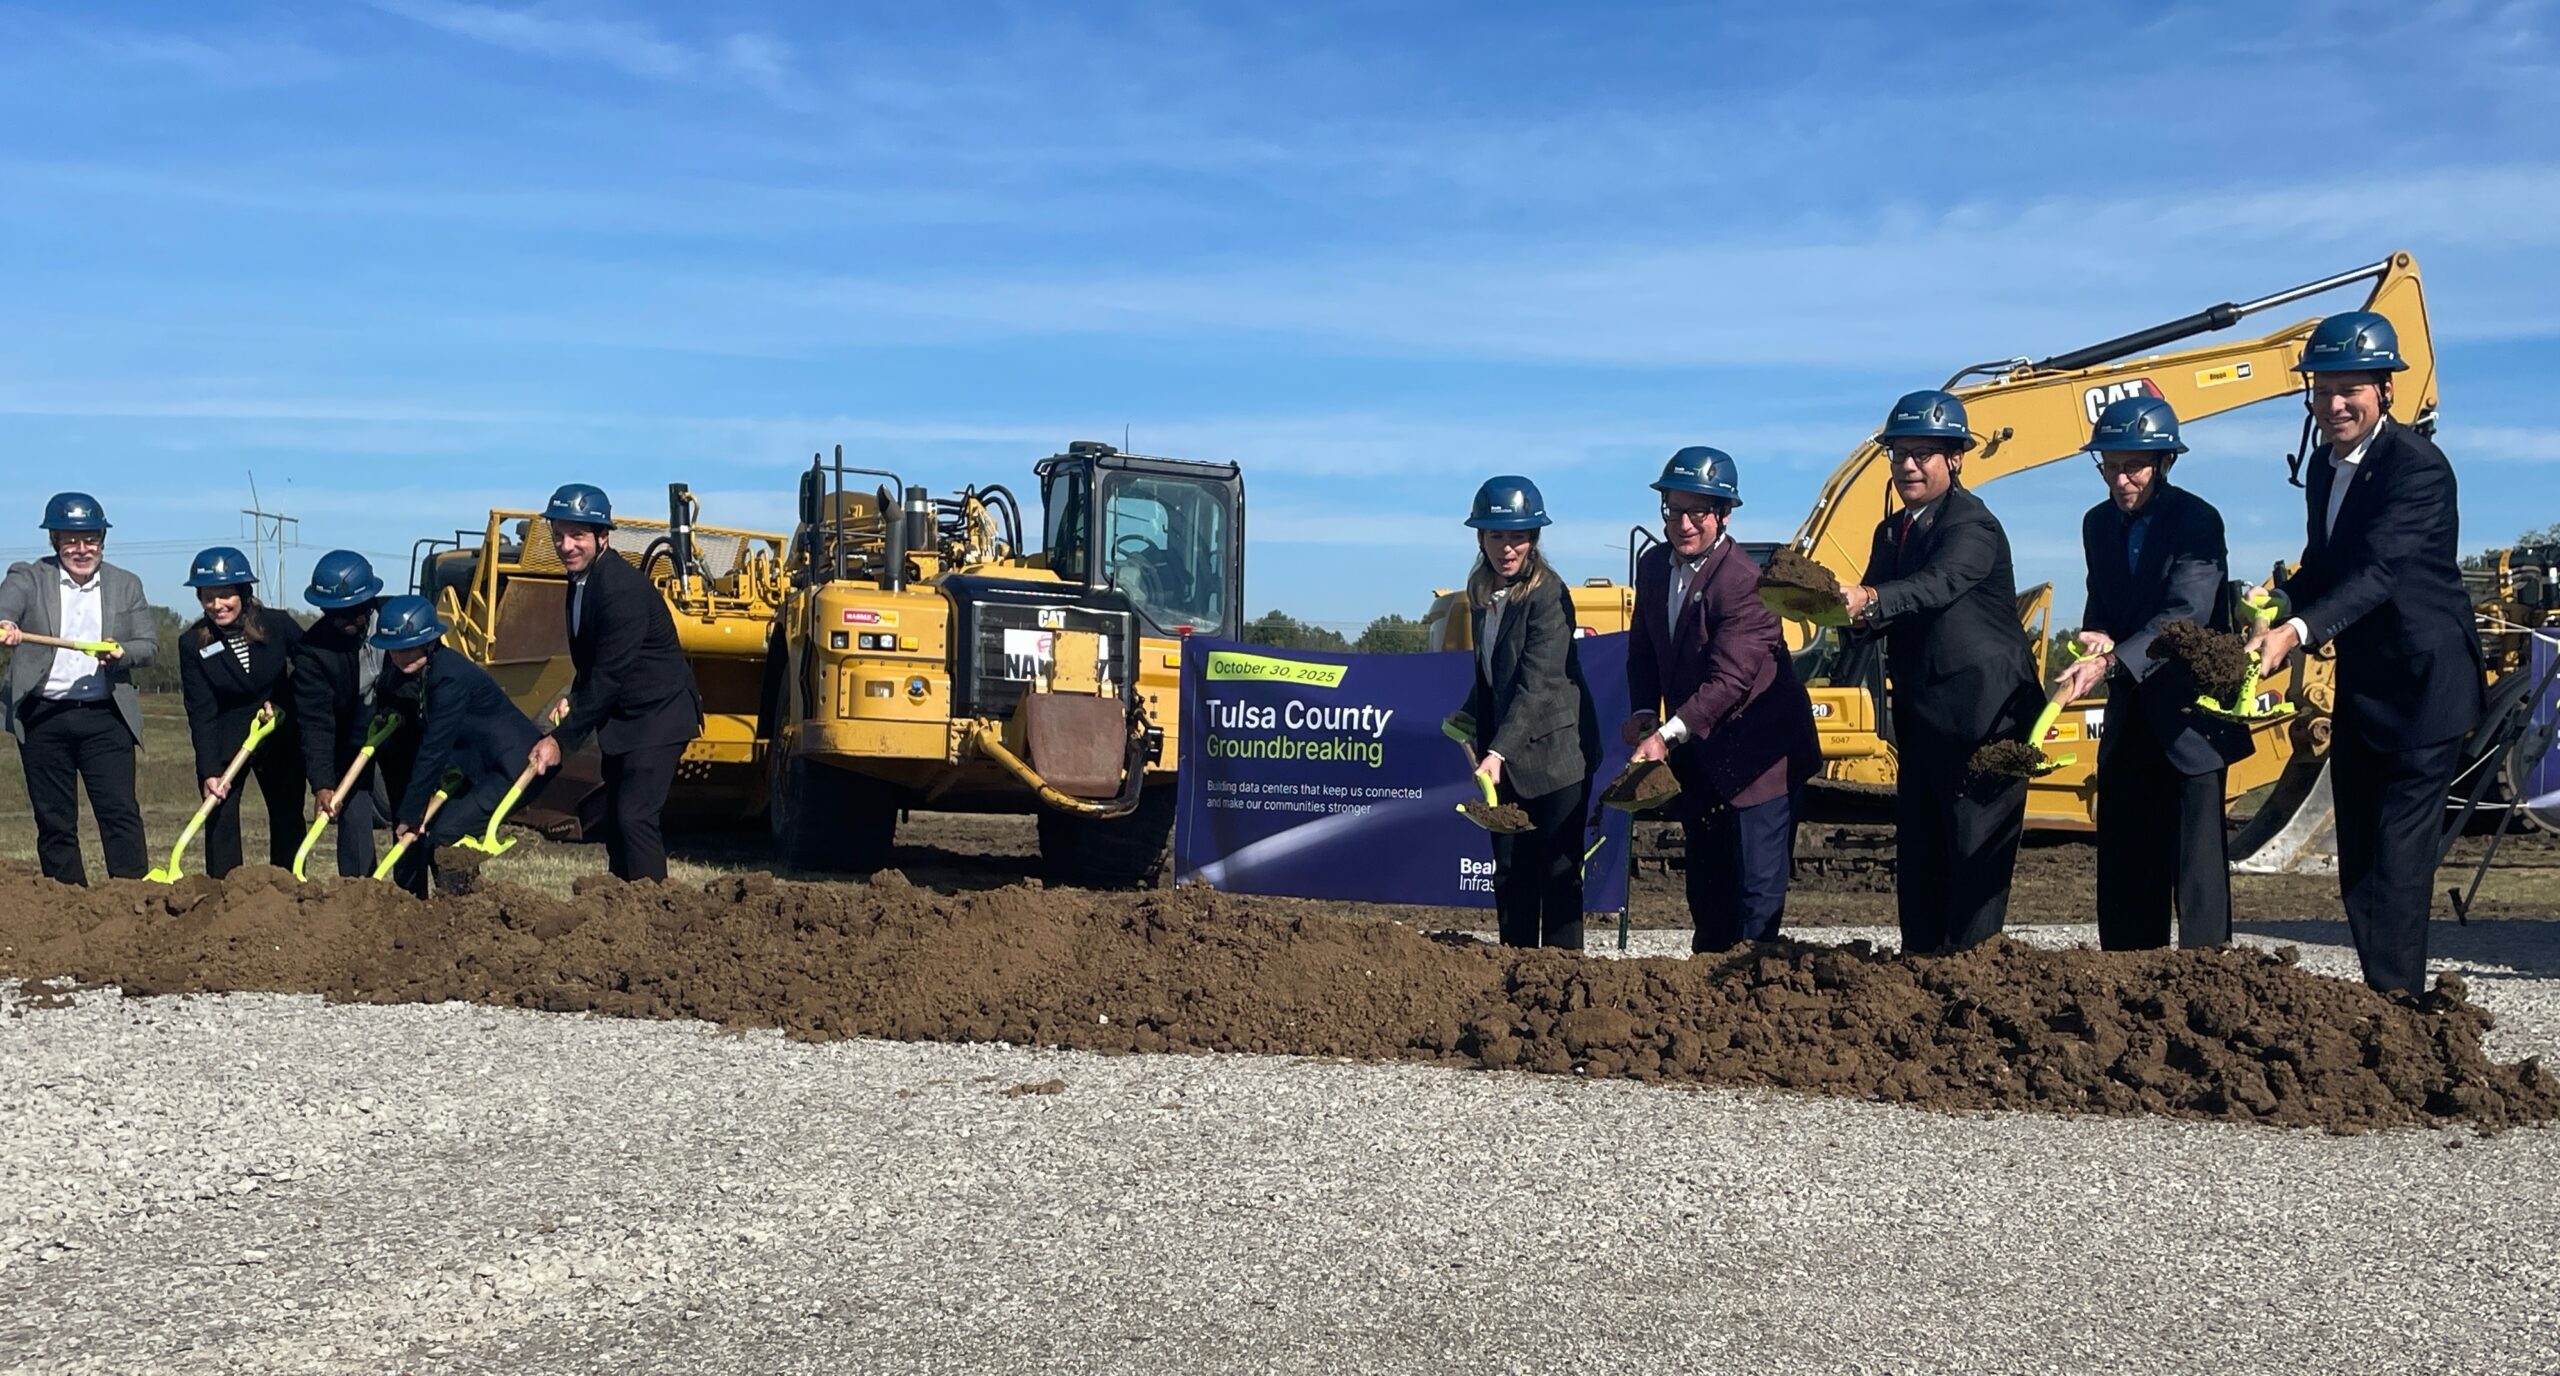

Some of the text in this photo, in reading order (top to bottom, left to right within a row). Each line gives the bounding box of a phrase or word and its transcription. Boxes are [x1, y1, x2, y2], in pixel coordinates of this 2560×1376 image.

[1038, 610, 1066, 628] CAT
[1214, 660, 1336, 682] October 30, 2025
[1206, 700, 1393, 738] Tulsa County
[1206, 734, 1383, 768] Groundbreaking
[1239, 782, 1260, 793] data
[1262, 784, 1298, 794] centers
[1301, 784, 1320, 795] that
[1323, 784, 1348, 798] keep
[1350, 787, 1363, 797] us
[1365, 787, 1423, 799] connected
[1206, 798, 1372, 816] and make our communities stronger
